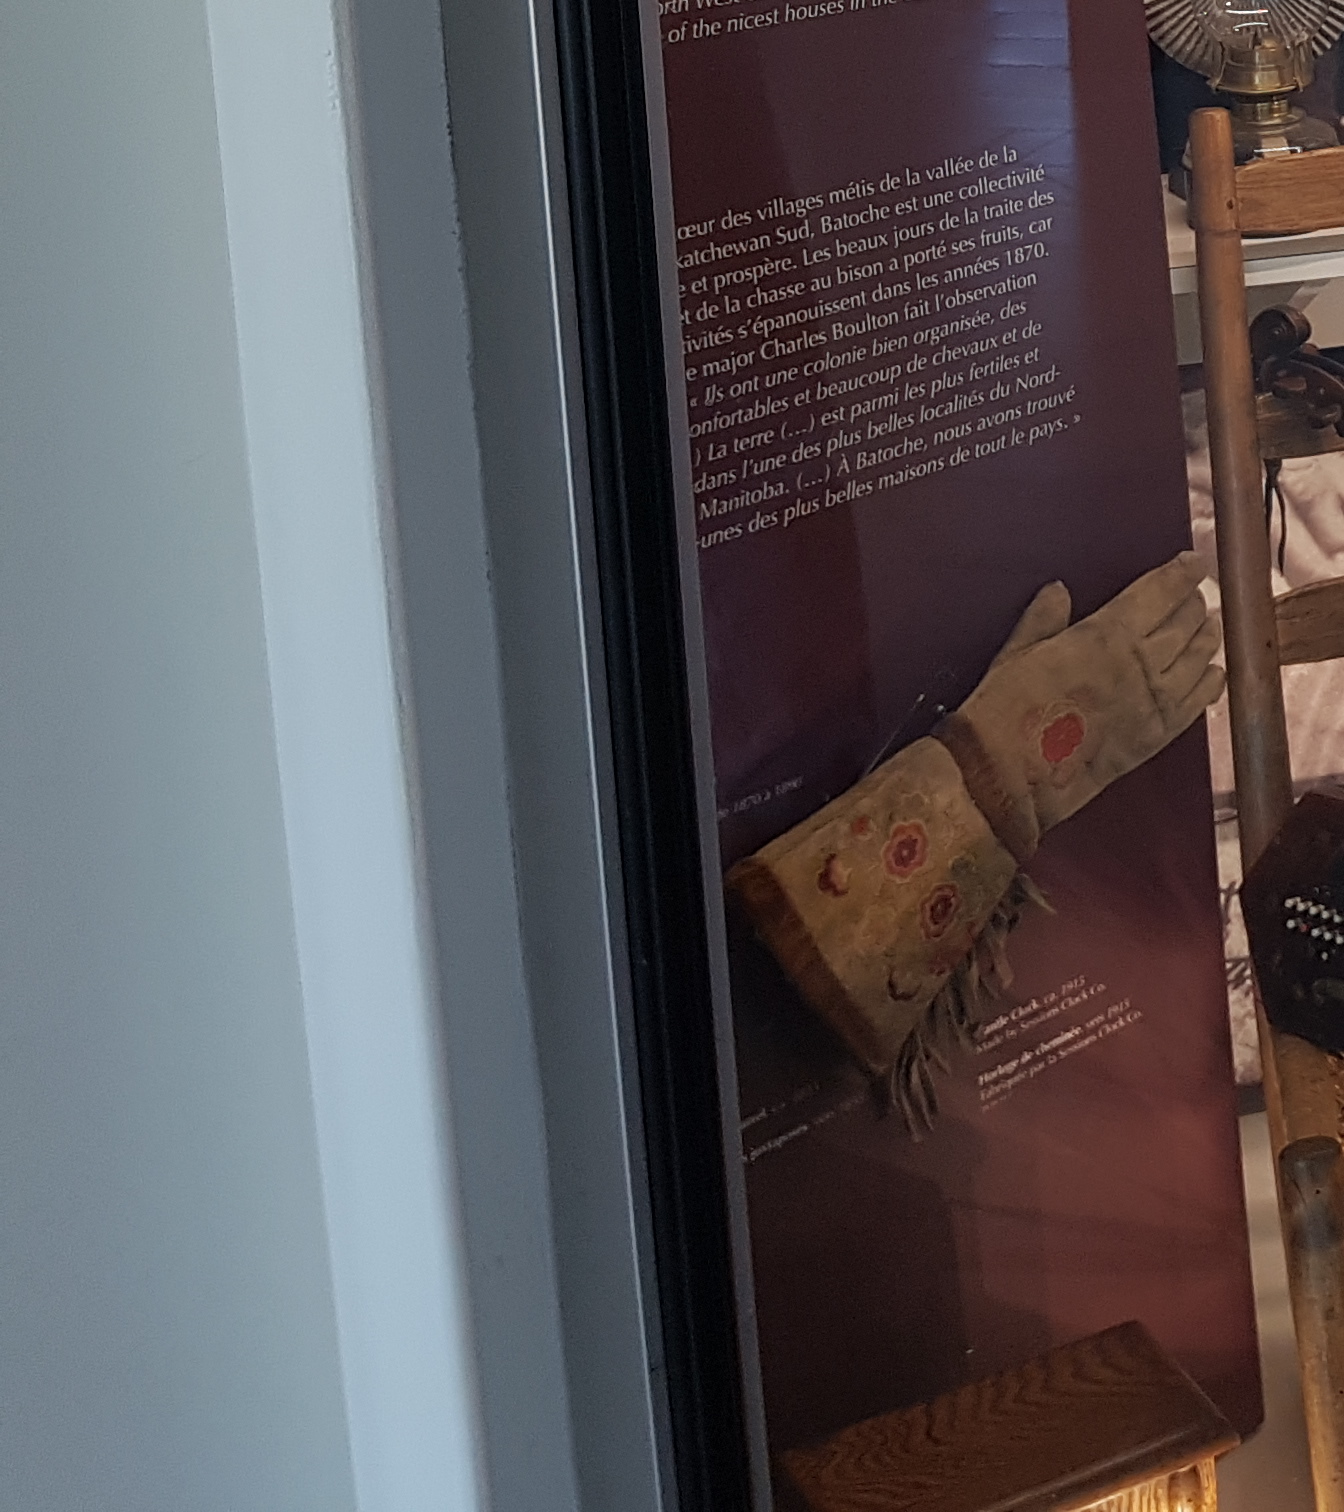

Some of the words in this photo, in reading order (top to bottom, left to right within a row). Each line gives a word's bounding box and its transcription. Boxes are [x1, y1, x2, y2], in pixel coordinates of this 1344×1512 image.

[667, 20, 688, 43] of
[692, 18, 721, 39] the
[727, 8, 778, 32] nicest
[784, 0, 844, 22] houses
[721, 209, 752, 230] des
[756, 194, 824, 220] villages
[829, 179, 875, 204] métis
[879, 172, 900, 192] de
[905, 167, 920, 186] la
[925, 156, 974, 181] vallée
[978, 150, 998, 169] de
[1003, 145, 1017, 163] la
